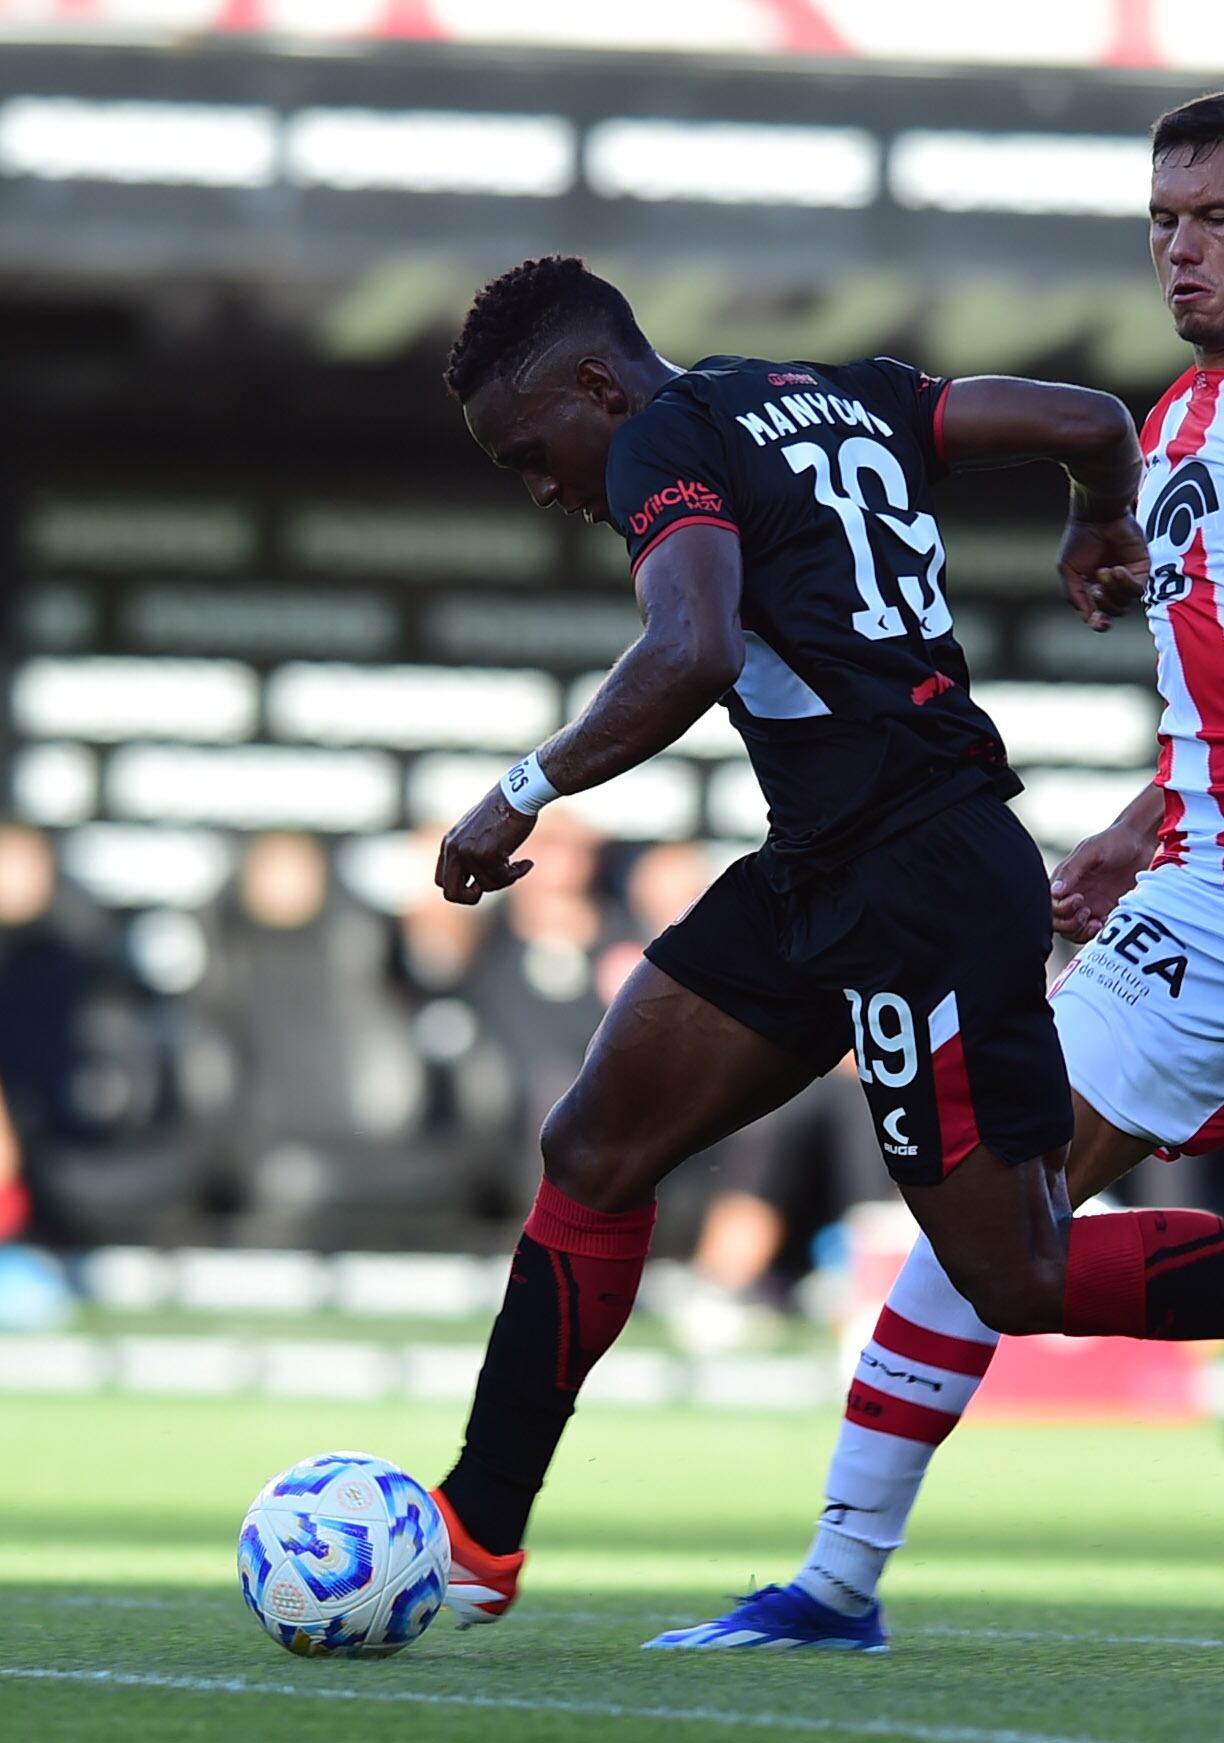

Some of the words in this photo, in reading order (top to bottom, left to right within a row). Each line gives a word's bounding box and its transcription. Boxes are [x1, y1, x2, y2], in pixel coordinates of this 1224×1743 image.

[781, 436, 954, 640] 19
[1078, 963, 1095, 979] de
[1096, 974, 1141, 1006] salud
[1087, 951, 1150, 998] cobertura
[1097, 913, 1189, 999] GEA
[843, 988, 919, 1089] 19
